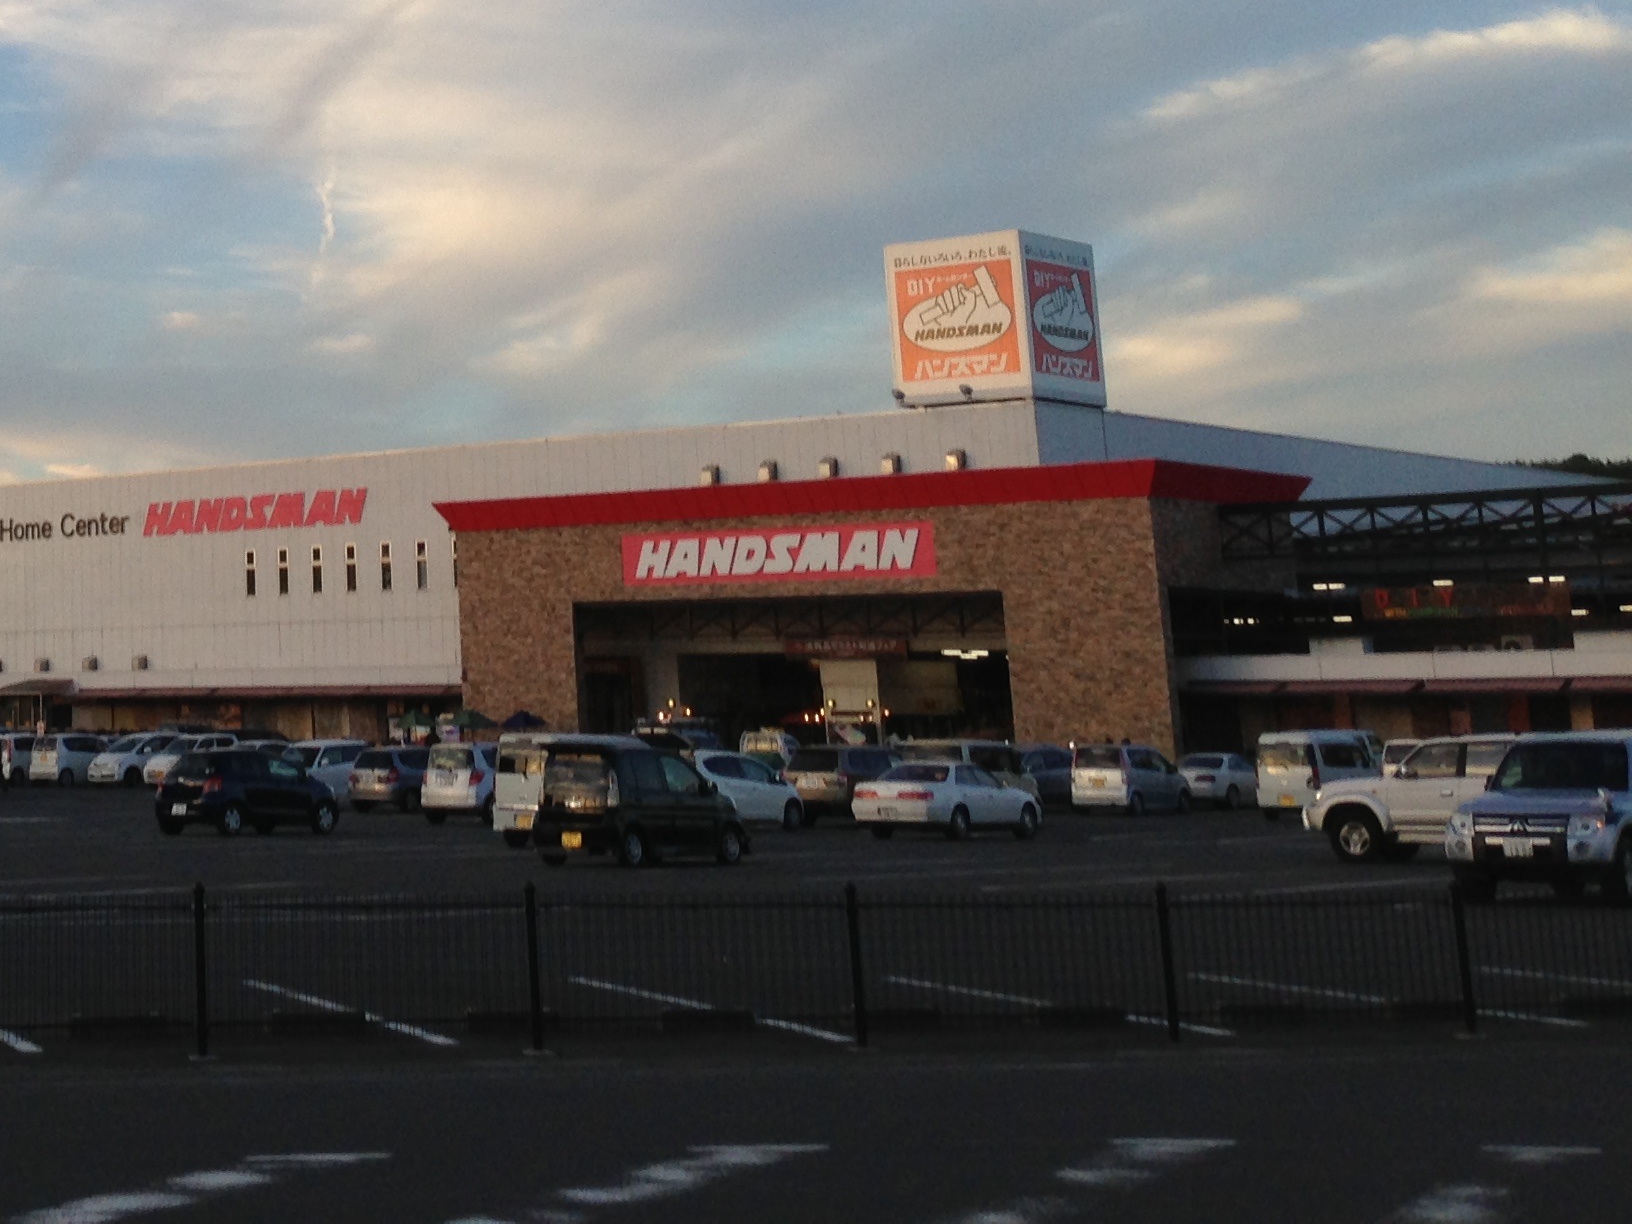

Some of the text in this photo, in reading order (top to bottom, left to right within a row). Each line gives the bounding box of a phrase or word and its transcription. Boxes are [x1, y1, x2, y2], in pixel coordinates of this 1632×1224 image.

[907, 276, 936, 296] DIY
[915, 322, 1003, 342] HANDSMAN
[1041, 323, 1089, 341] HANDSMAN
[0, 517, 53, 543] Home
[60, 512, 129, 538] Center
[143, 487, 367, 538] HANDSMAN
[635, 528, 919, 580] HANDSMAN
